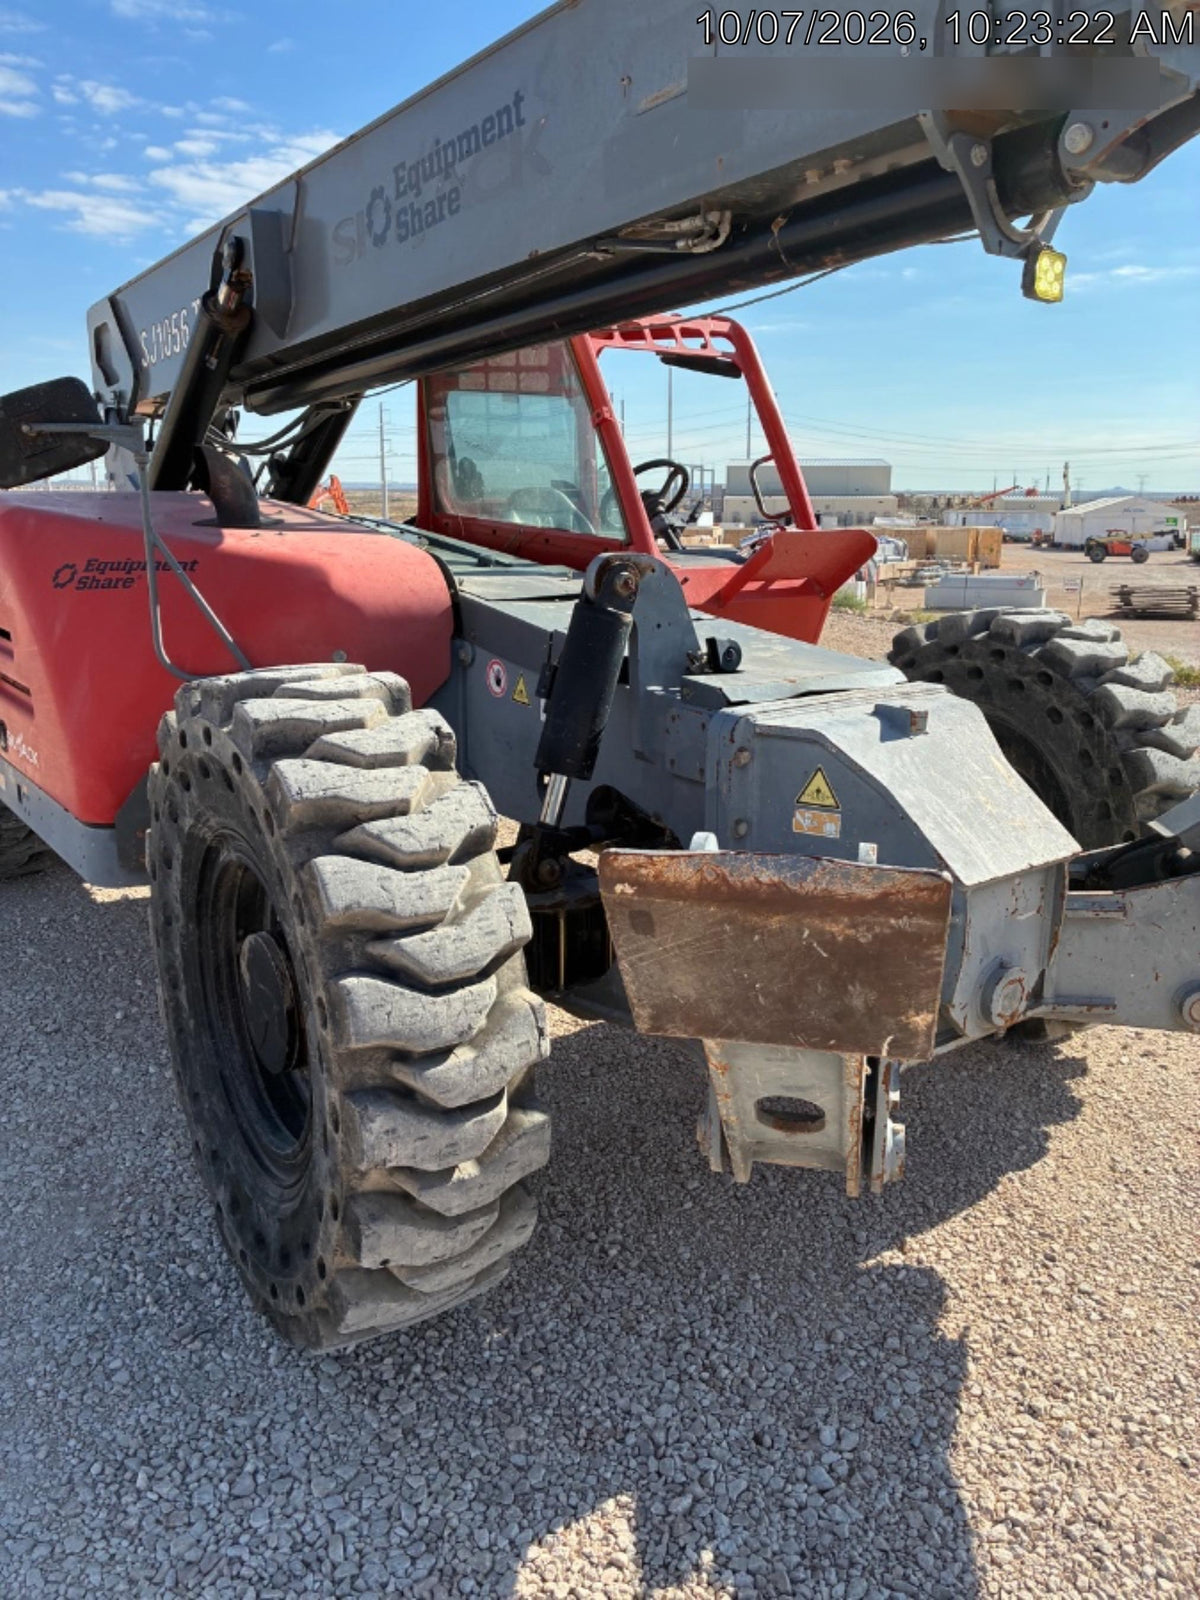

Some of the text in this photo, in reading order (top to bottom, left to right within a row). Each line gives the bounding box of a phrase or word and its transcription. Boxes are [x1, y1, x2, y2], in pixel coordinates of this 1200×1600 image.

[393, 90, 526, 201] Equipment
[395, 185, 461, 245] Share
[140, 308, 190, 368] SJ1056
[75, 575, 135, 591] Share
